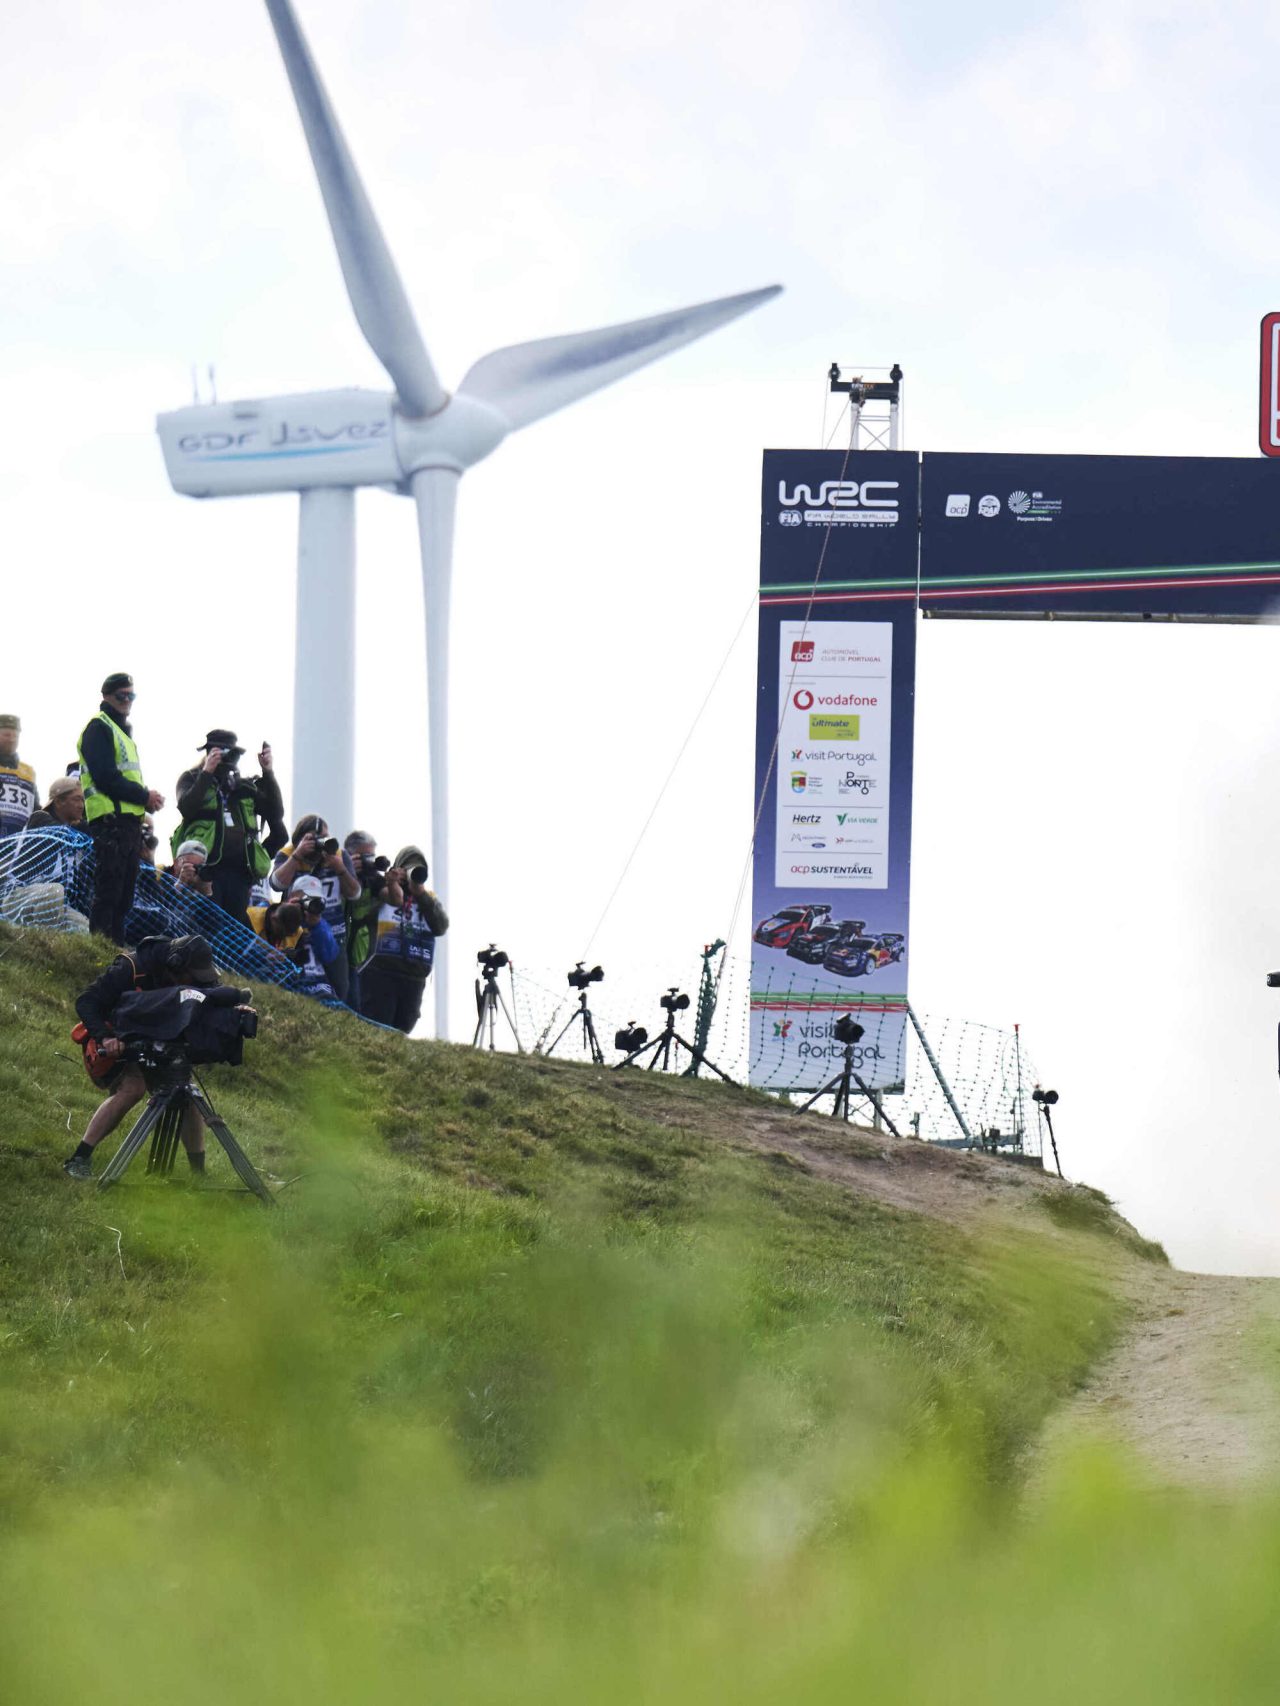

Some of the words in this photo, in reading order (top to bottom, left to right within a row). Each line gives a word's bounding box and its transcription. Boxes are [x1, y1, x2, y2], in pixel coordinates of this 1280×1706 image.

[779, 480, 899, 506] WRC
[817, 694, 878, 706] vodafone
[805, 751, 825, 761] visit
[827, 750, 877, 767] Portugal
[792, 813, 822, 824] Hertz
[811, 864, 874, 874] SUSTENTÁVEL
